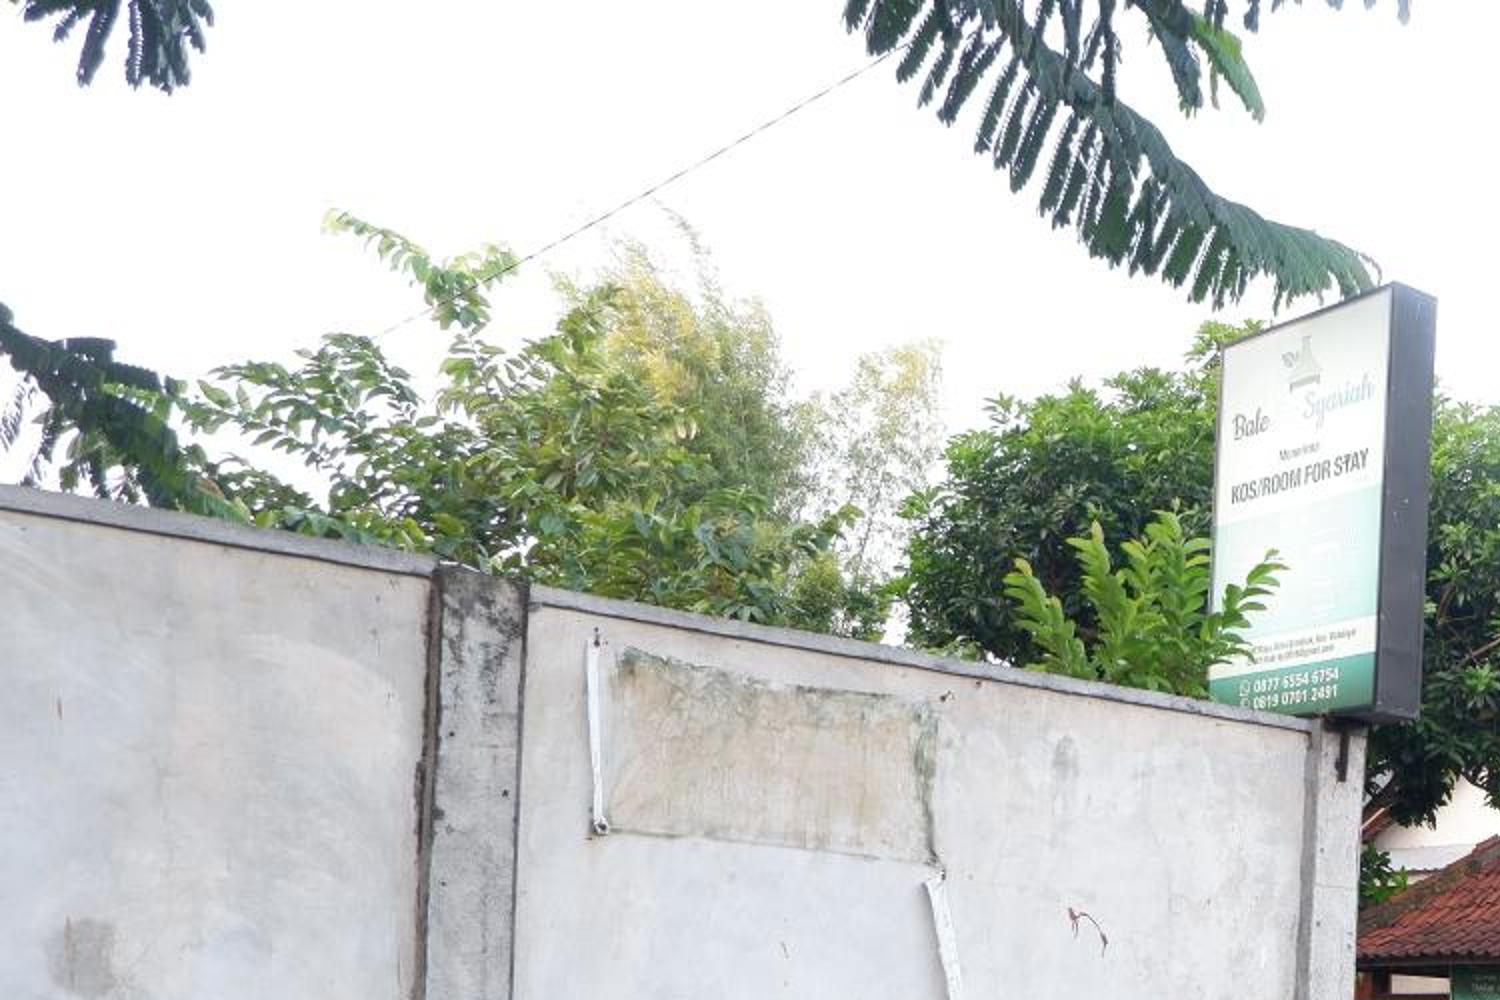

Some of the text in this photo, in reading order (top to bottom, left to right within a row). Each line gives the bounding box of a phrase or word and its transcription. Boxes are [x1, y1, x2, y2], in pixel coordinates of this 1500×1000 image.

[1232, 406, 1270, 441] Bale
[1304, 459, 1331, 485] FOR
[1333, 447, 1369, 477] STAY
